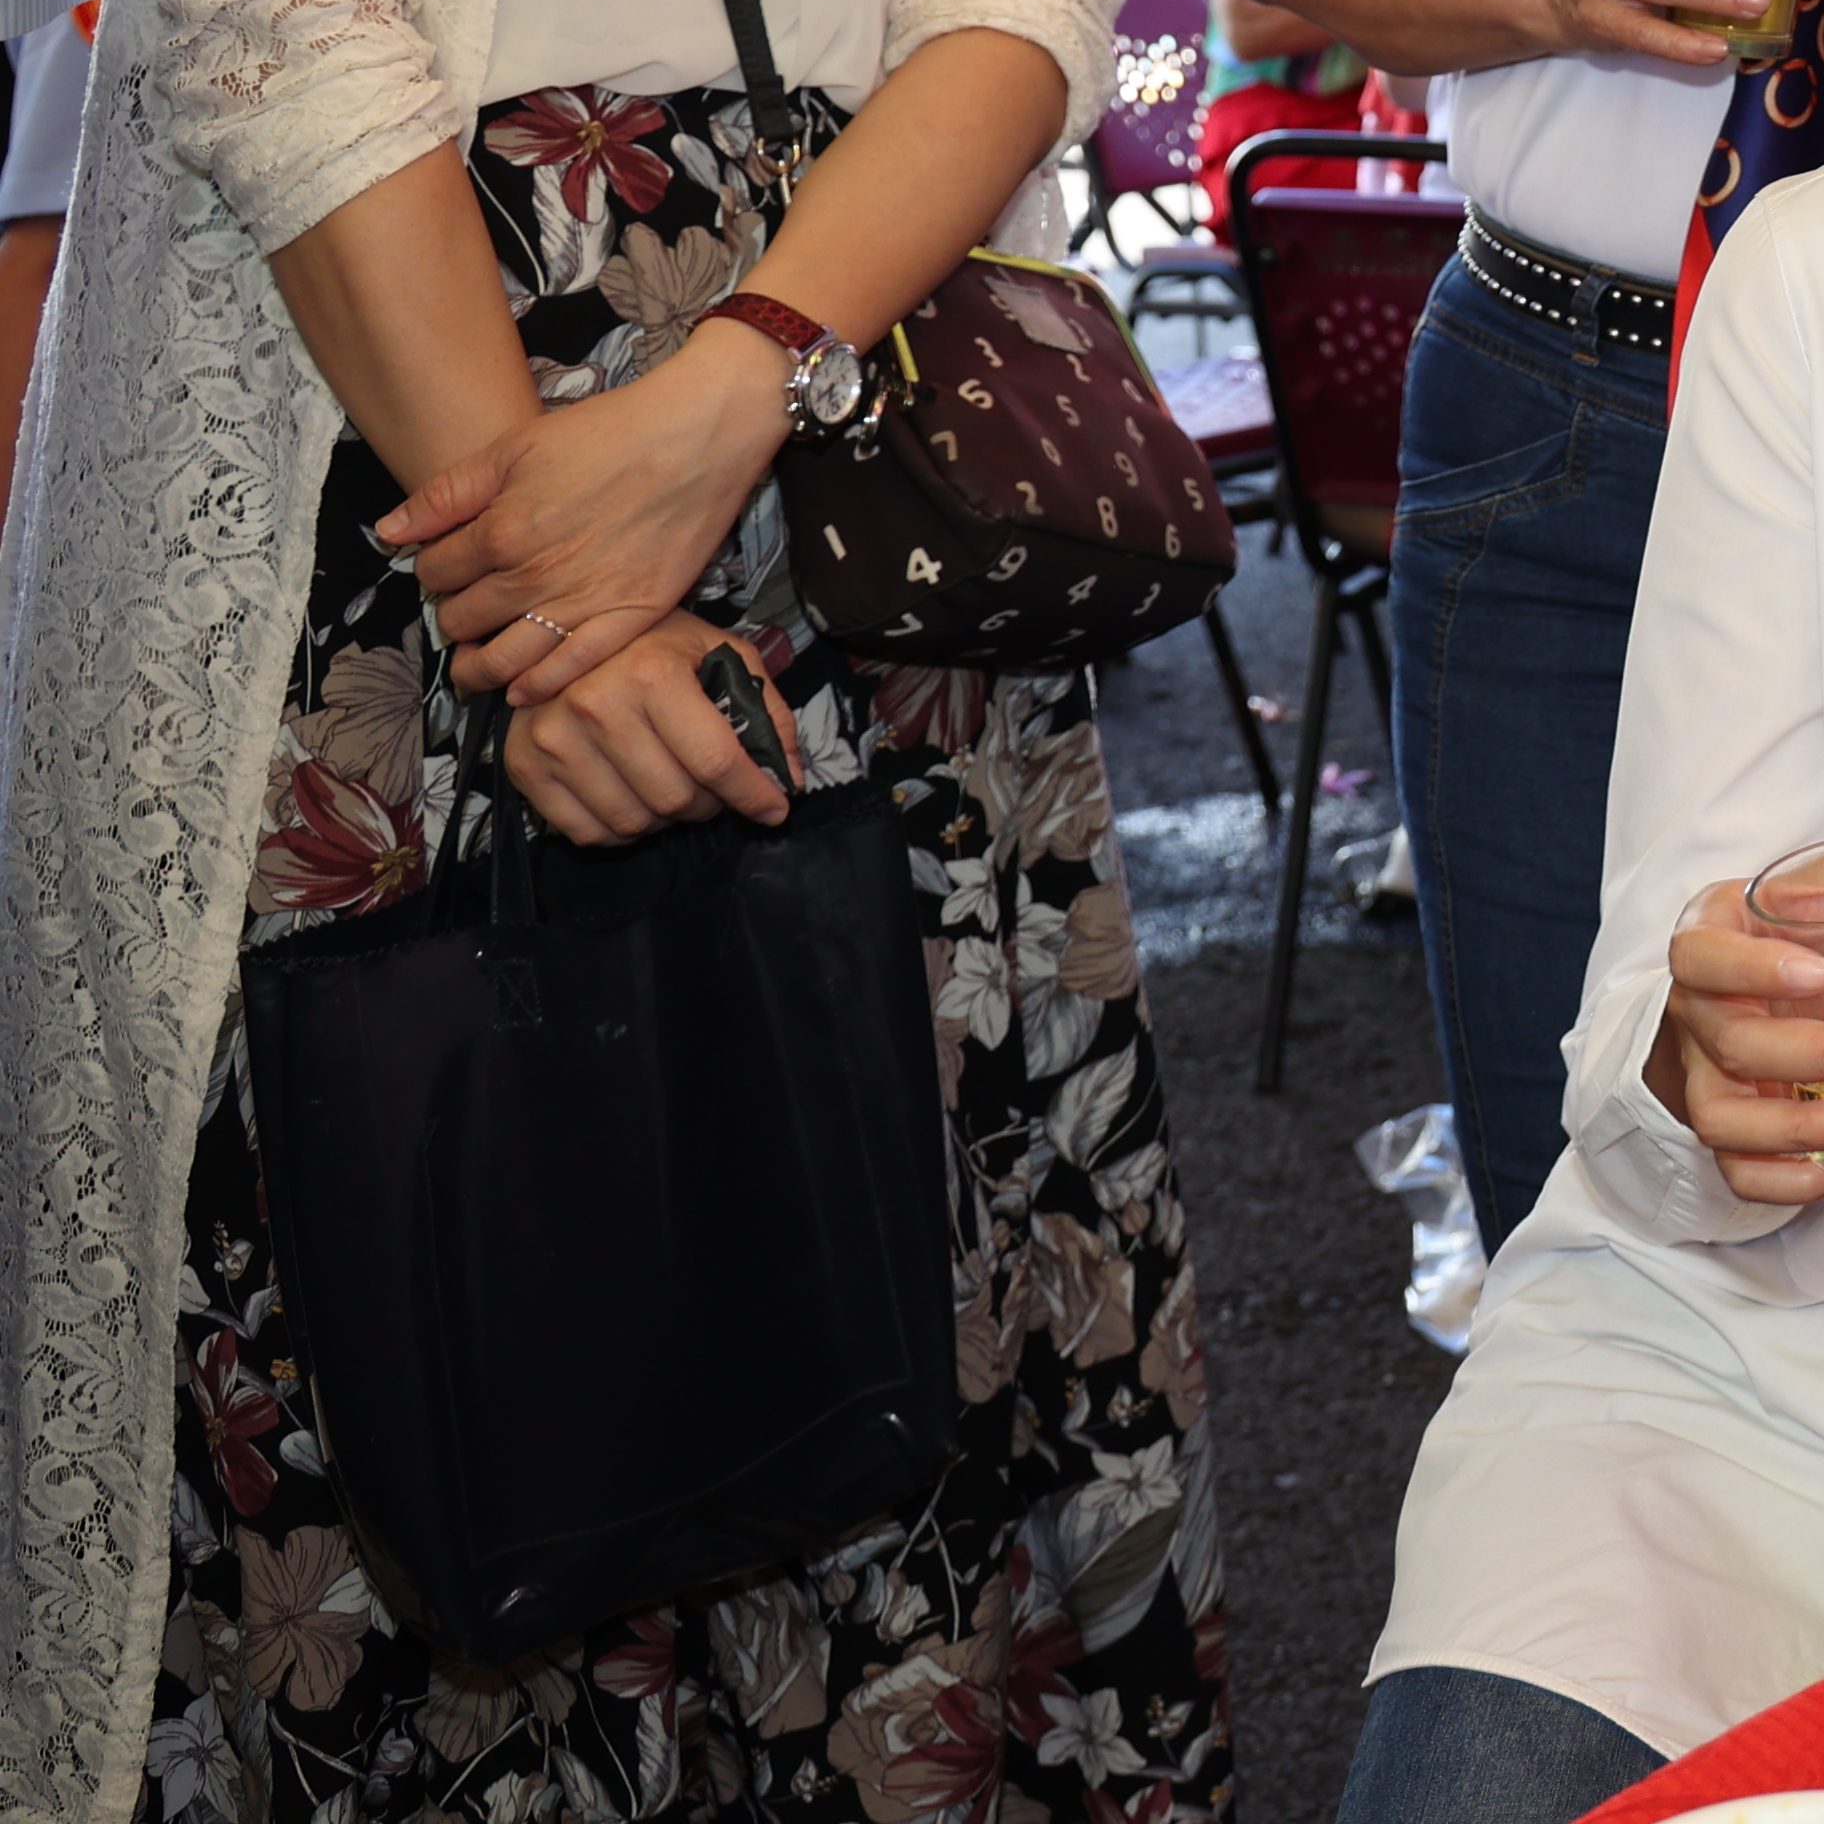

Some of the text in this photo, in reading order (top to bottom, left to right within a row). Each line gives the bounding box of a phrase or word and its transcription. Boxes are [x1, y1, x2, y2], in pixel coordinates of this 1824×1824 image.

[930, 430, 958, 462] 7
[1113, 451, 1139, 487] 9
[1015, 480, 1045, 516] 2
[1183, 478, 1205, 511] 5
[1096, 496, 1119, 538] 8
[1164, 523, 1181, 558] 6
[906, 547, 943, 585] 4
[986, 546, 1028, 581] 9
[1067, 575, 1099, 605] 4
